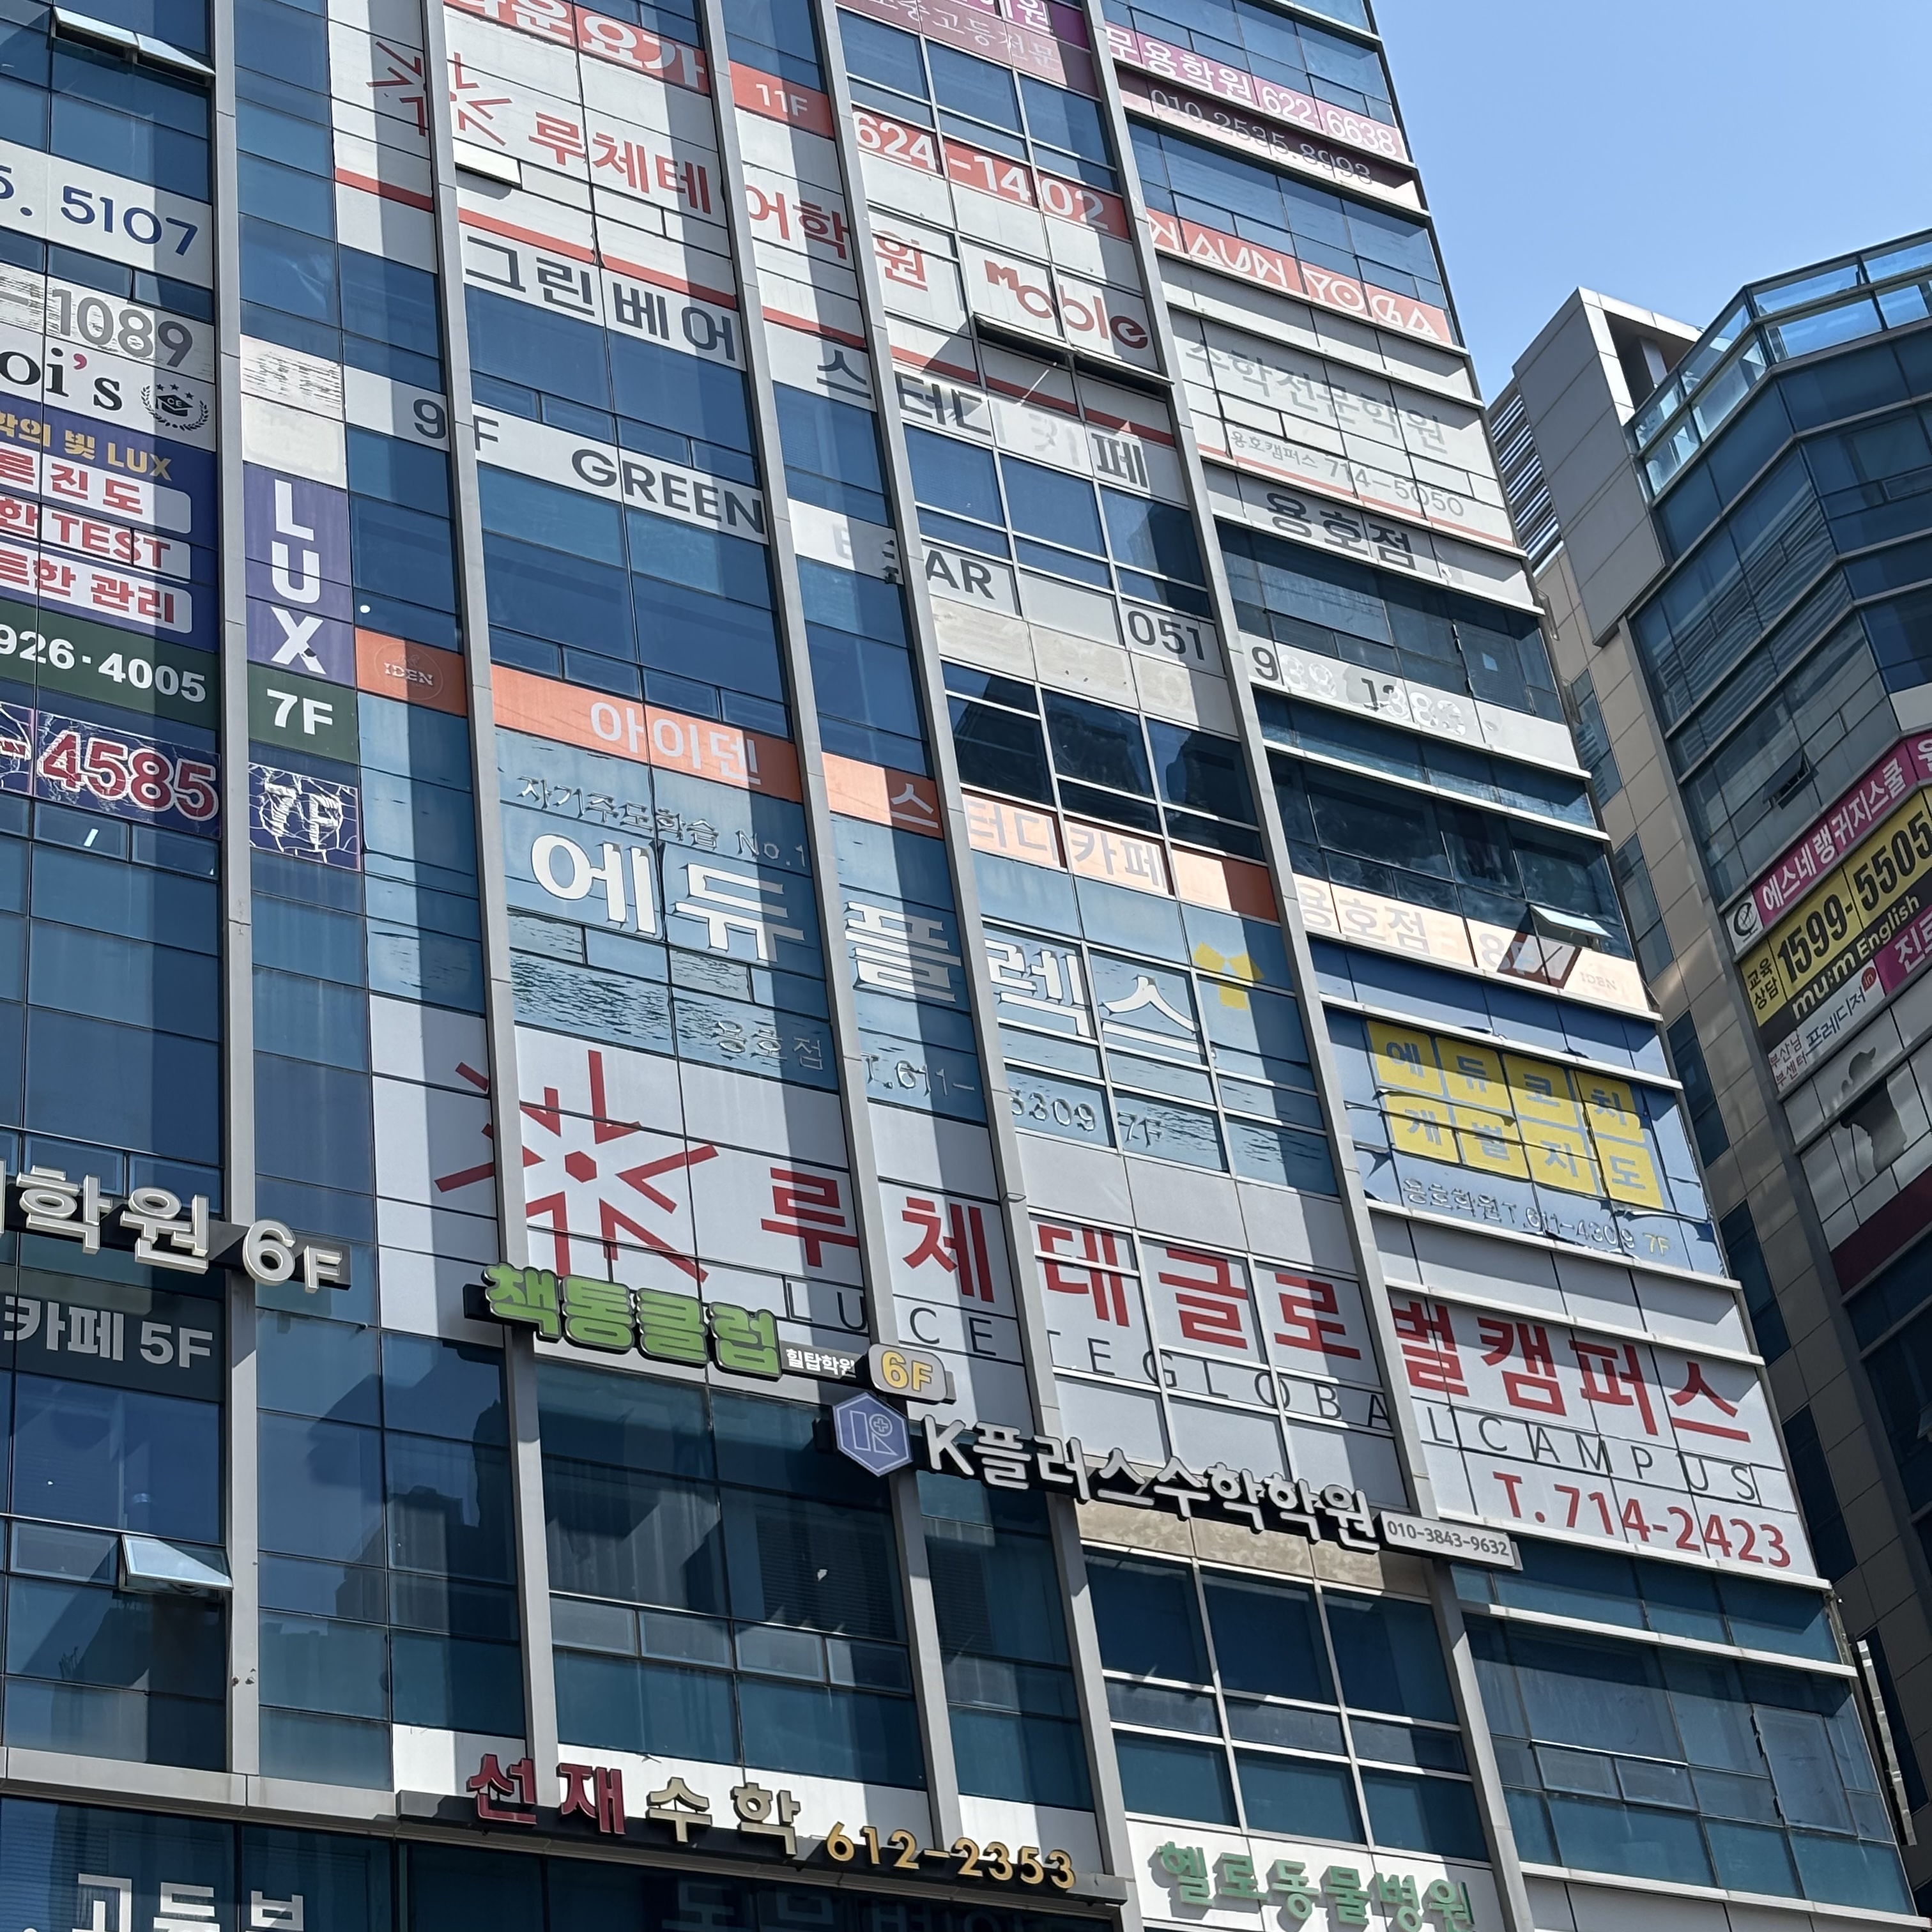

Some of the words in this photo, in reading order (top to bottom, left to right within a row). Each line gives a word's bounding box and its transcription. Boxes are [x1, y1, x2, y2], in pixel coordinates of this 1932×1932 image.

[1107, 29, 1259, 106] 무용학원
[755, 82, 808, 118] 11F
[852, 111, 1108, 230] 624-1402
[465, 234, 735, 362] 그린베어
[107, 442, 172, 482] LUX
[572, 448, 765, 535] GREEN
[1324, 457, 1464, 518] 714-5050
[51, 512, 171, 569] TEST
[1266, 492, 1417, 571] 용호점
[91, 573, 174, 624] 관리
[1128, 610, 1205, 662] 051
[383, 661, 433, 687] IDEN
[266, 689, 334, 735] 7F
[590, 702, 762, 786] 아이덴
[1856, 895, 1920, 961] English
[1747, 957, 1774, 991] 교육
[1753, 977, 1779, 1011] 상담
[1386, 1041, 1627, 1126] 에듀코치
[0, 1160, 210, 1275] 학원
[242, 1219, 344, 1293] 6F
[1641, 1232, 1670, 1257] 7F
[3, 1295, 125, 1361] 카페
[139, 1320, 213, 1368] 5F
[881, 1350, 933, 1392] 6F
[921, 1413, 1381, 1554] K플러스수학학원
[1386, 1519, 1510, 1558] 010-3843-9632
[1491, 1470, 1791, 1569] T.714-2423
[466, 1753, 627, 1836] 선재
[646, 1776, 801, 1857] 수학
[826, 1821, 1077, 1890] 612-2353
